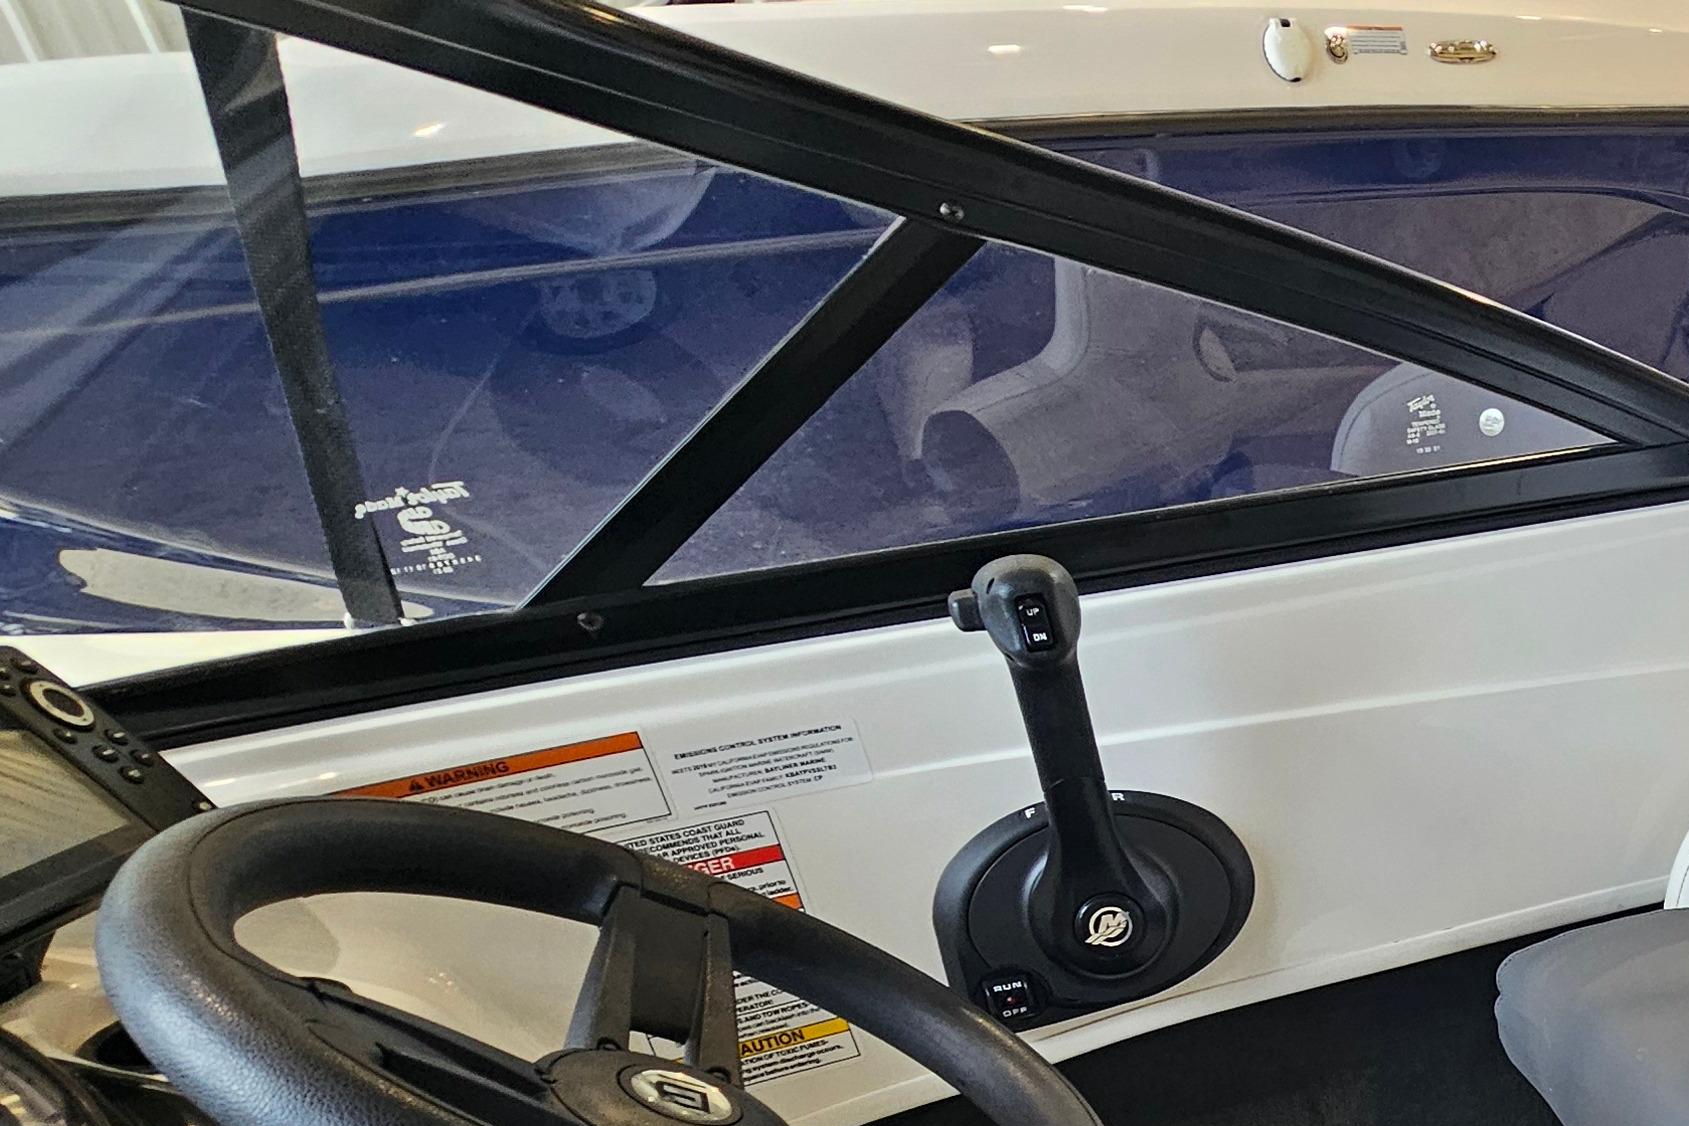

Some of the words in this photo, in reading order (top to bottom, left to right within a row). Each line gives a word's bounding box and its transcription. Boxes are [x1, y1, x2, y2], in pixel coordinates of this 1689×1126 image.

[1026, 607, 1040, 616] UP
[1032, 632, 1048, 642] DN
[674, 747, 718, 760] EMISSIONS
[719, 740, 757, 752] CONTROL
[757, 734, 789, 745] SYSTEM
[790, 725, 842, 739] INFORMATION
[764, 762, 798, 774] BAYLINER
[799, 757, 826, 767] MARINE
[425, 761, 510, 788] WARNING
[1111, 792, 1126, 801] R
[1024, 807, 1036, 819] F
[648, 832, 682, 845] STATES
[682, 825, 712, 837] COAST
[713, 819, 745, 831] GUARD
[701, 831, 723, 842] THAT
[725, 828, 742, 837] ALL
[671, 842, 718, 856] APPROVED
[719, 832, 766, 847] PERSONAL
[727, 867, 764, 881] SERIOUS
[992, 980, 1023, 993] RUN
[755, 990, 771, 1000] THE
[1002, 1006, 1028, 1018] OFF
[741, 1029, 806, 1056] AUTION
[775, 1047, 800, 1058] TOXIC
